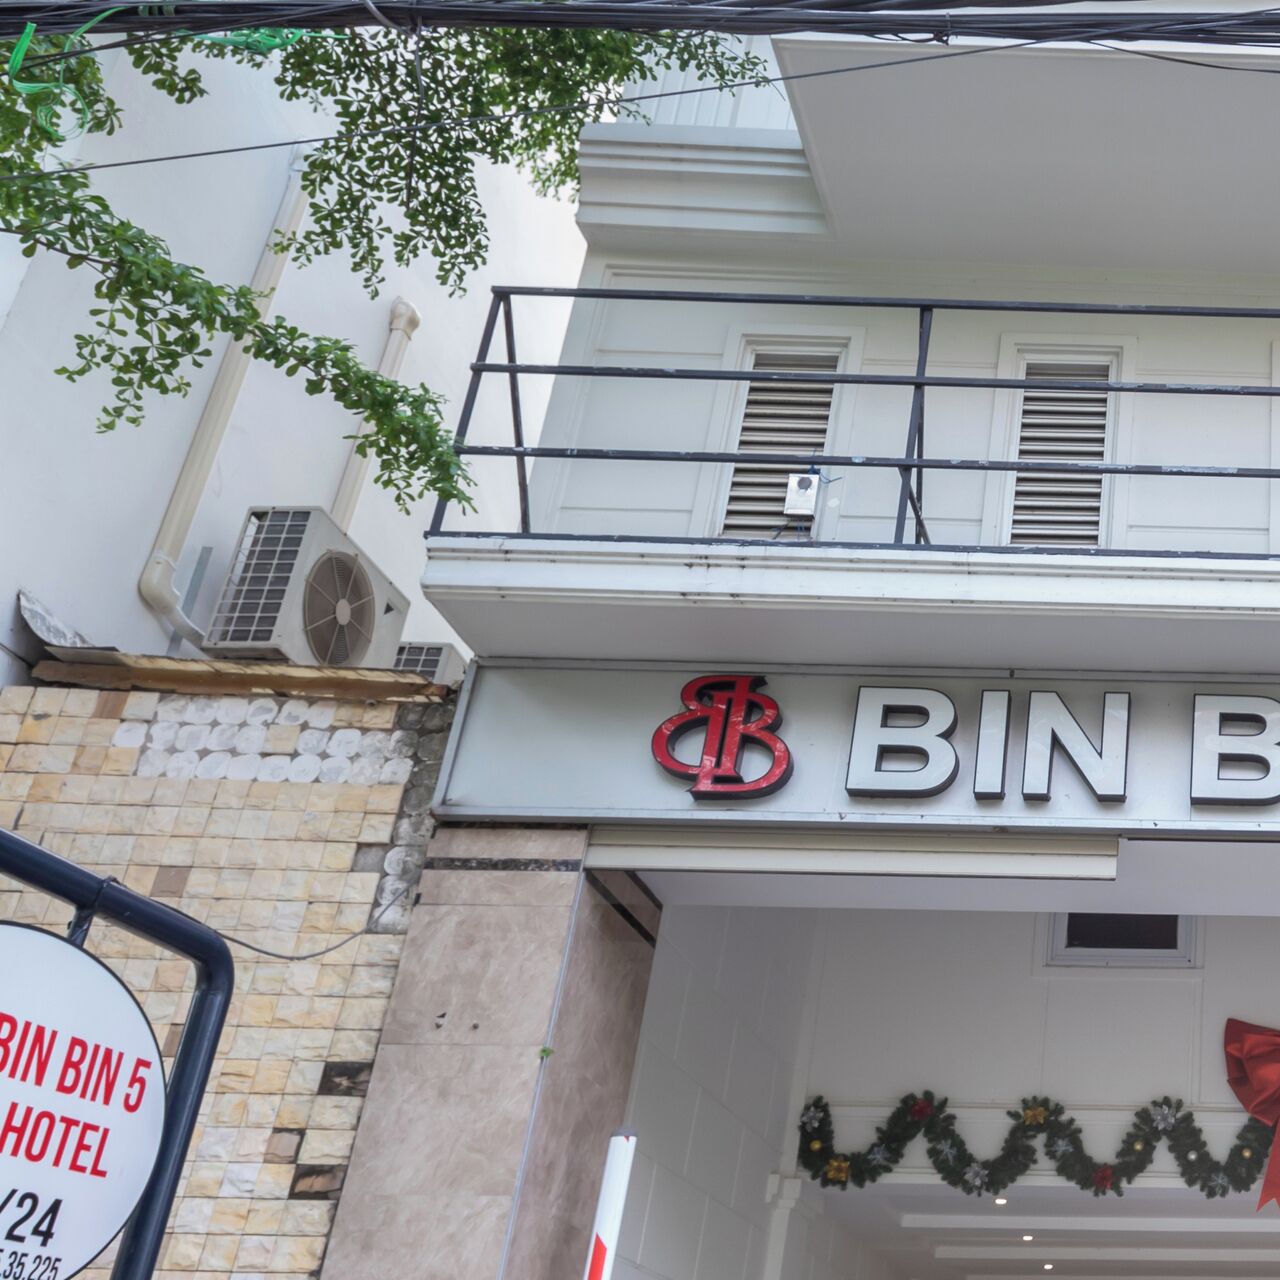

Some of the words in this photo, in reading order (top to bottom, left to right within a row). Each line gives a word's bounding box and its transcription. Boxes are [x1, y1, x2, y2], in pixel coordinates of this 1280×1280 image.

[845, 685, 1131, 802] BIN
[56, 1036, 124, 1106] BIN
[123, 1057, 152, 1113] 5
[0, 1101, 110, 1178] HOTEL
